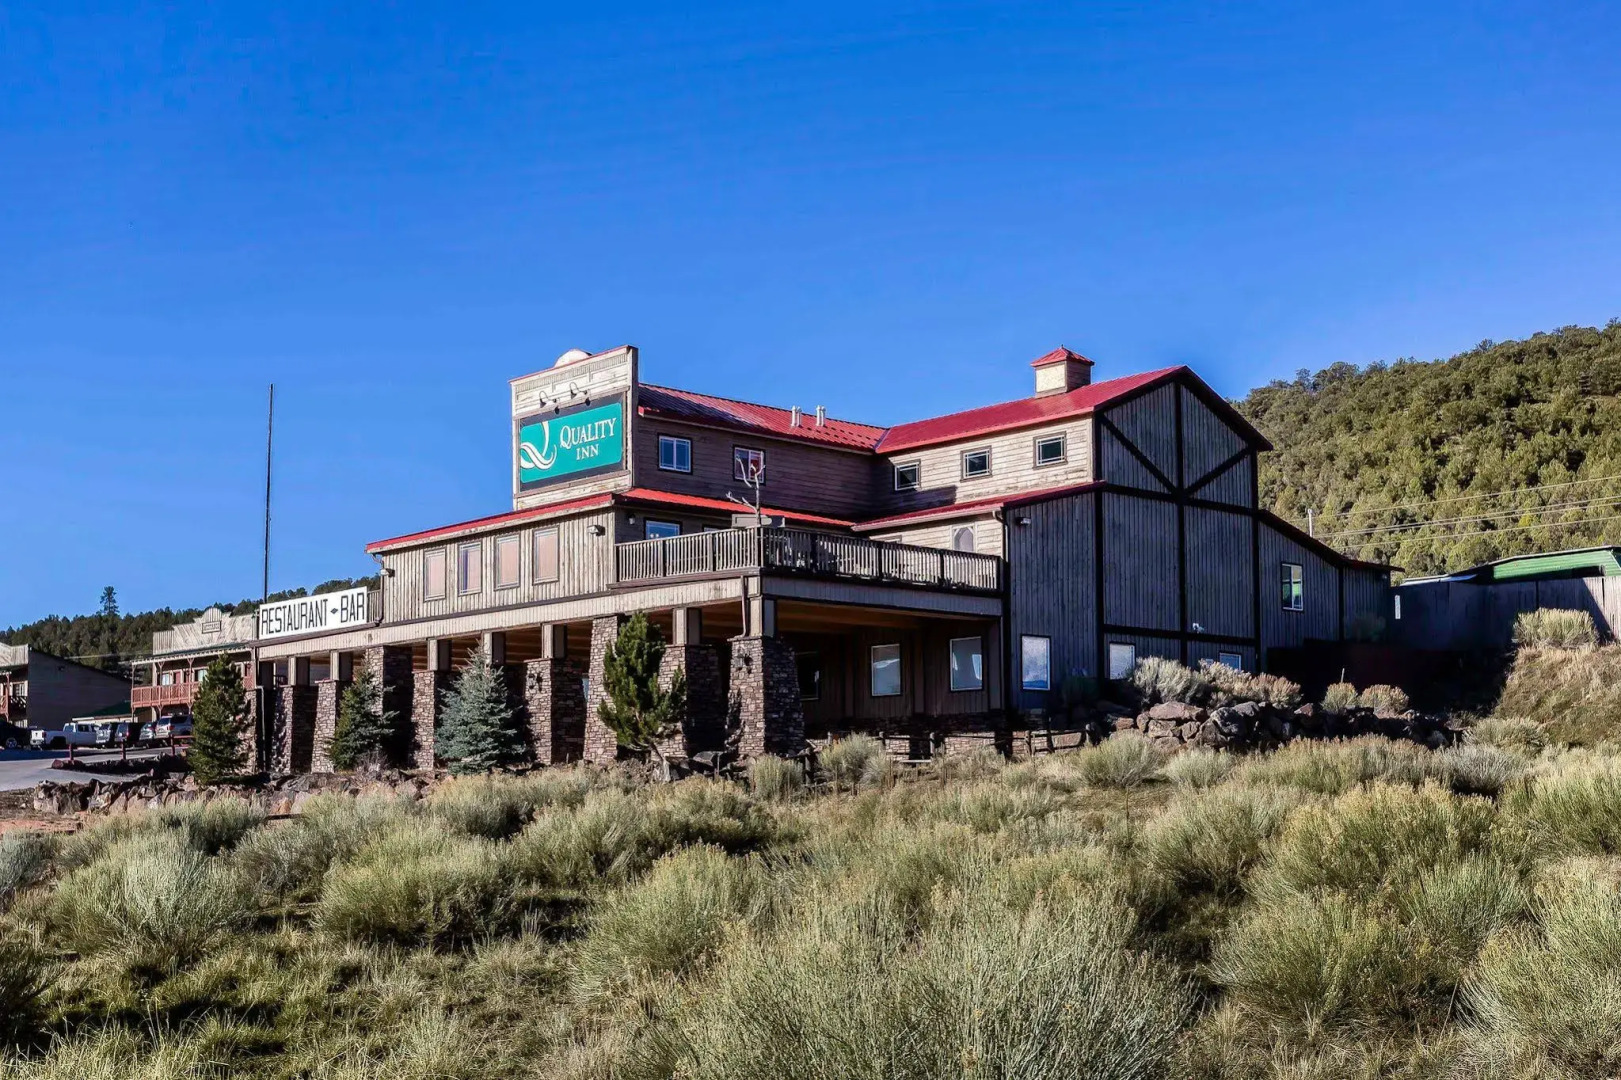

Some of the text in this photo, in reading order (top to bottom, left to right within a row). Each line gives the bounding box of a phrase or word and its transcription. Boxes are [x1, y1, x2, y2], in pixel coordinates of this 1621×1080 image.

[560, 418, 616, 449] QUALITY
[577, 444, 599, 460] INN
[261, 592, 364, 635] RESTAURANT BAR
